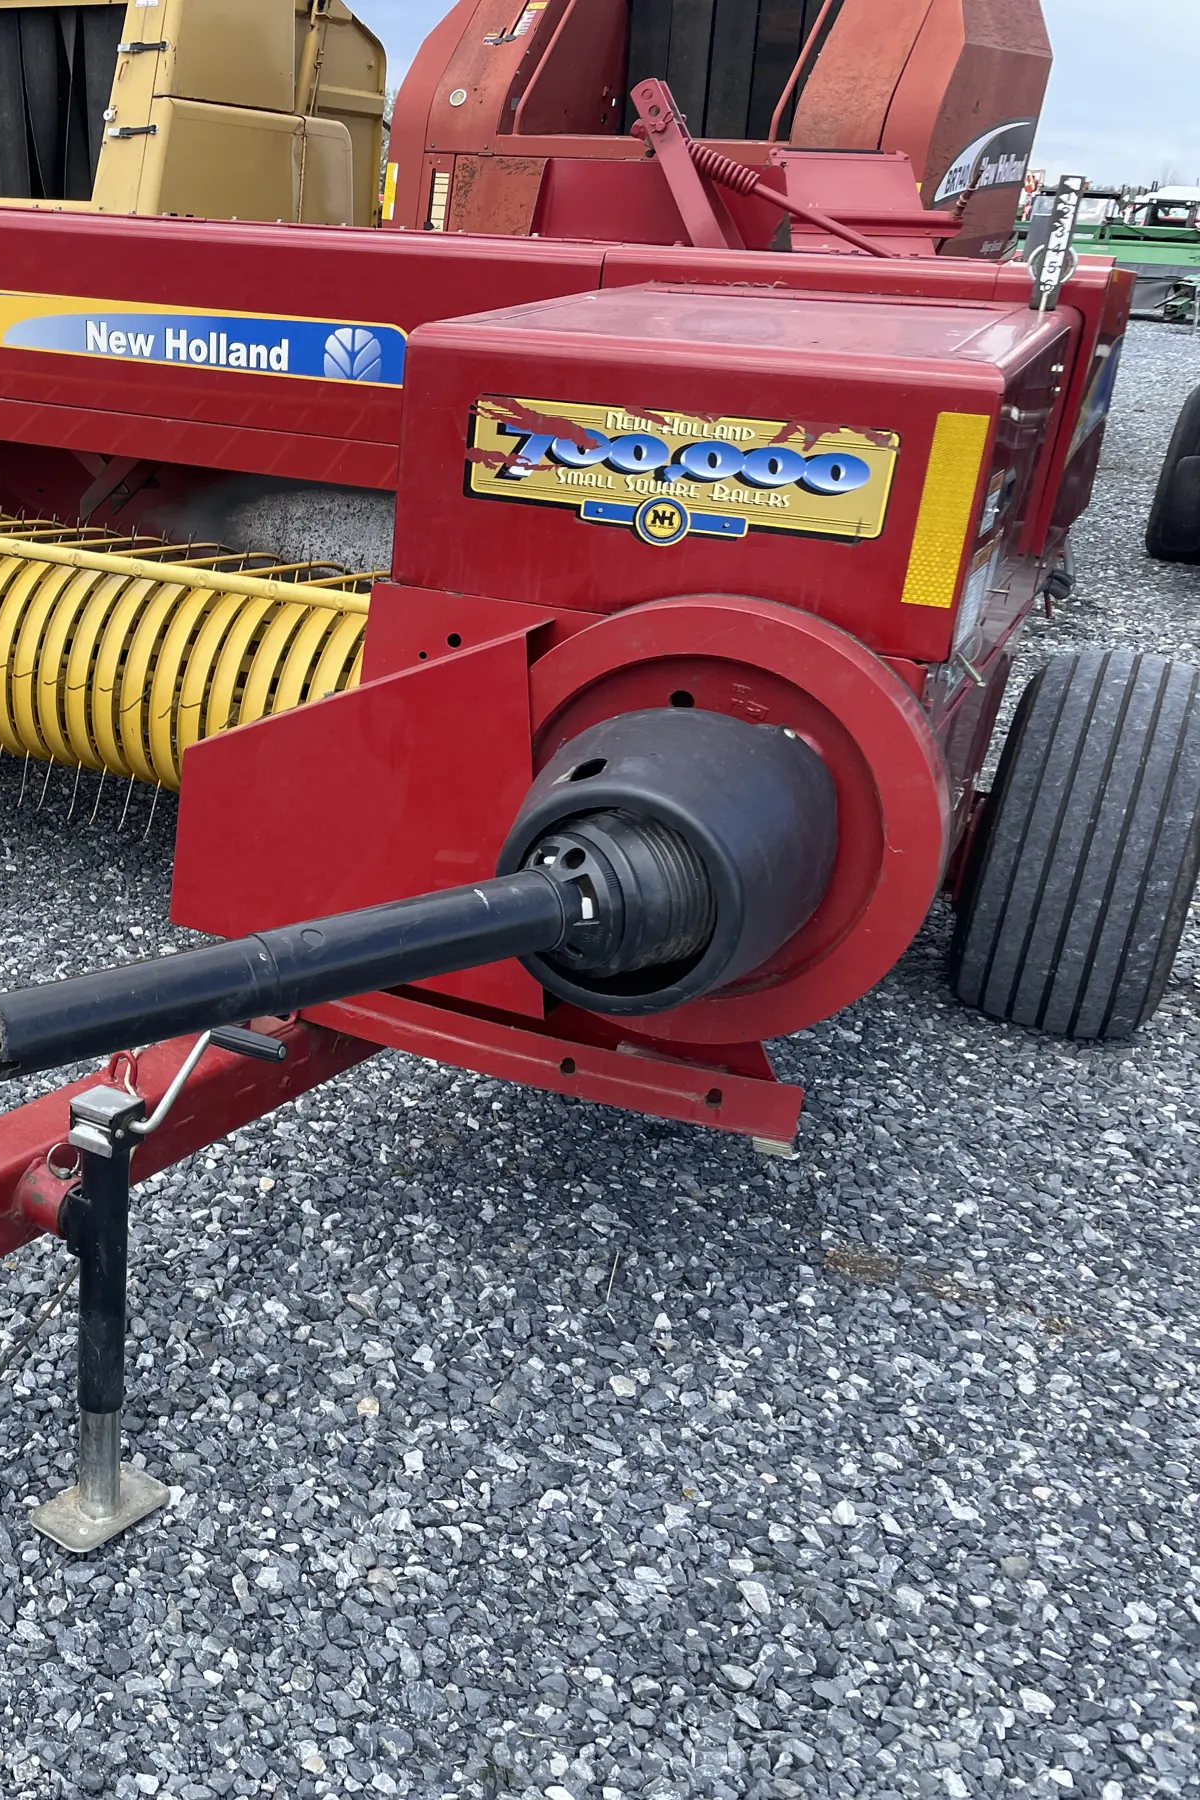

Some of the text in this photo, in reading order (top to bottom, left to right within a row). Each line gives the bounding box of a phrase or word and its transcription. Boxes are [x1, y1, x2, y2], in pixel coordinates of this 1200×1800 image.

[995, 153, 1028, 183] Holland
[1047, 261, 1057, 274] 5
[85, 320, 289, 371] New Holland
[656, 416, 756, 441] HOLLAND
[555, 467, 791, 509] SMALL SQUARE BALERS
[650, 509, 676, 526] NH
